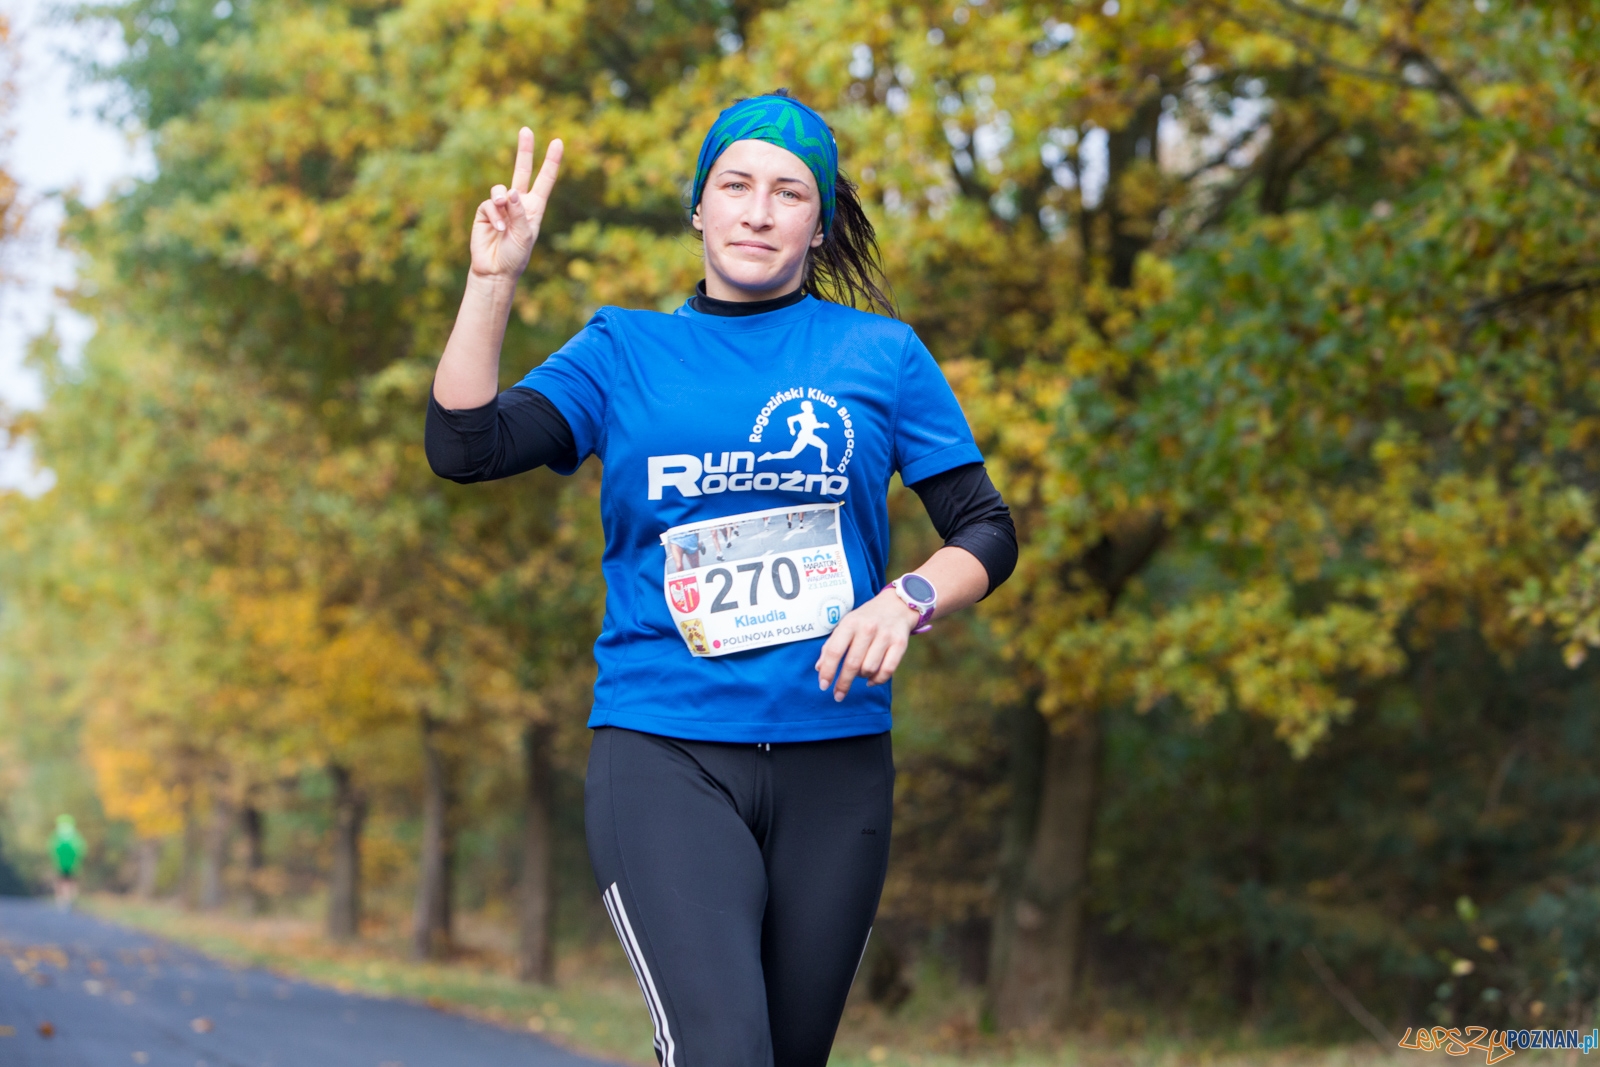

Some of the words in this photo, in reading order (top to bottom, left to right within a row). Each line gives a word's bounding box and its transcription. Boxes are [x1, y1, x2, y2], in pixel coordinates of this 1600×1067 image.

[749, 387, 804, 443] Rogoziński
[807, 387, 838, 408] Klub
[837, 406, 855, 474] Biegacza
[803, 560, 837, 570] MARATON
[705, 557, 801, 614] 270
[735, 610, 787, 628] Klaudia
[722, 630, 774, 647] POLINOVA
[776, 624, 814, 638] POLSKA
